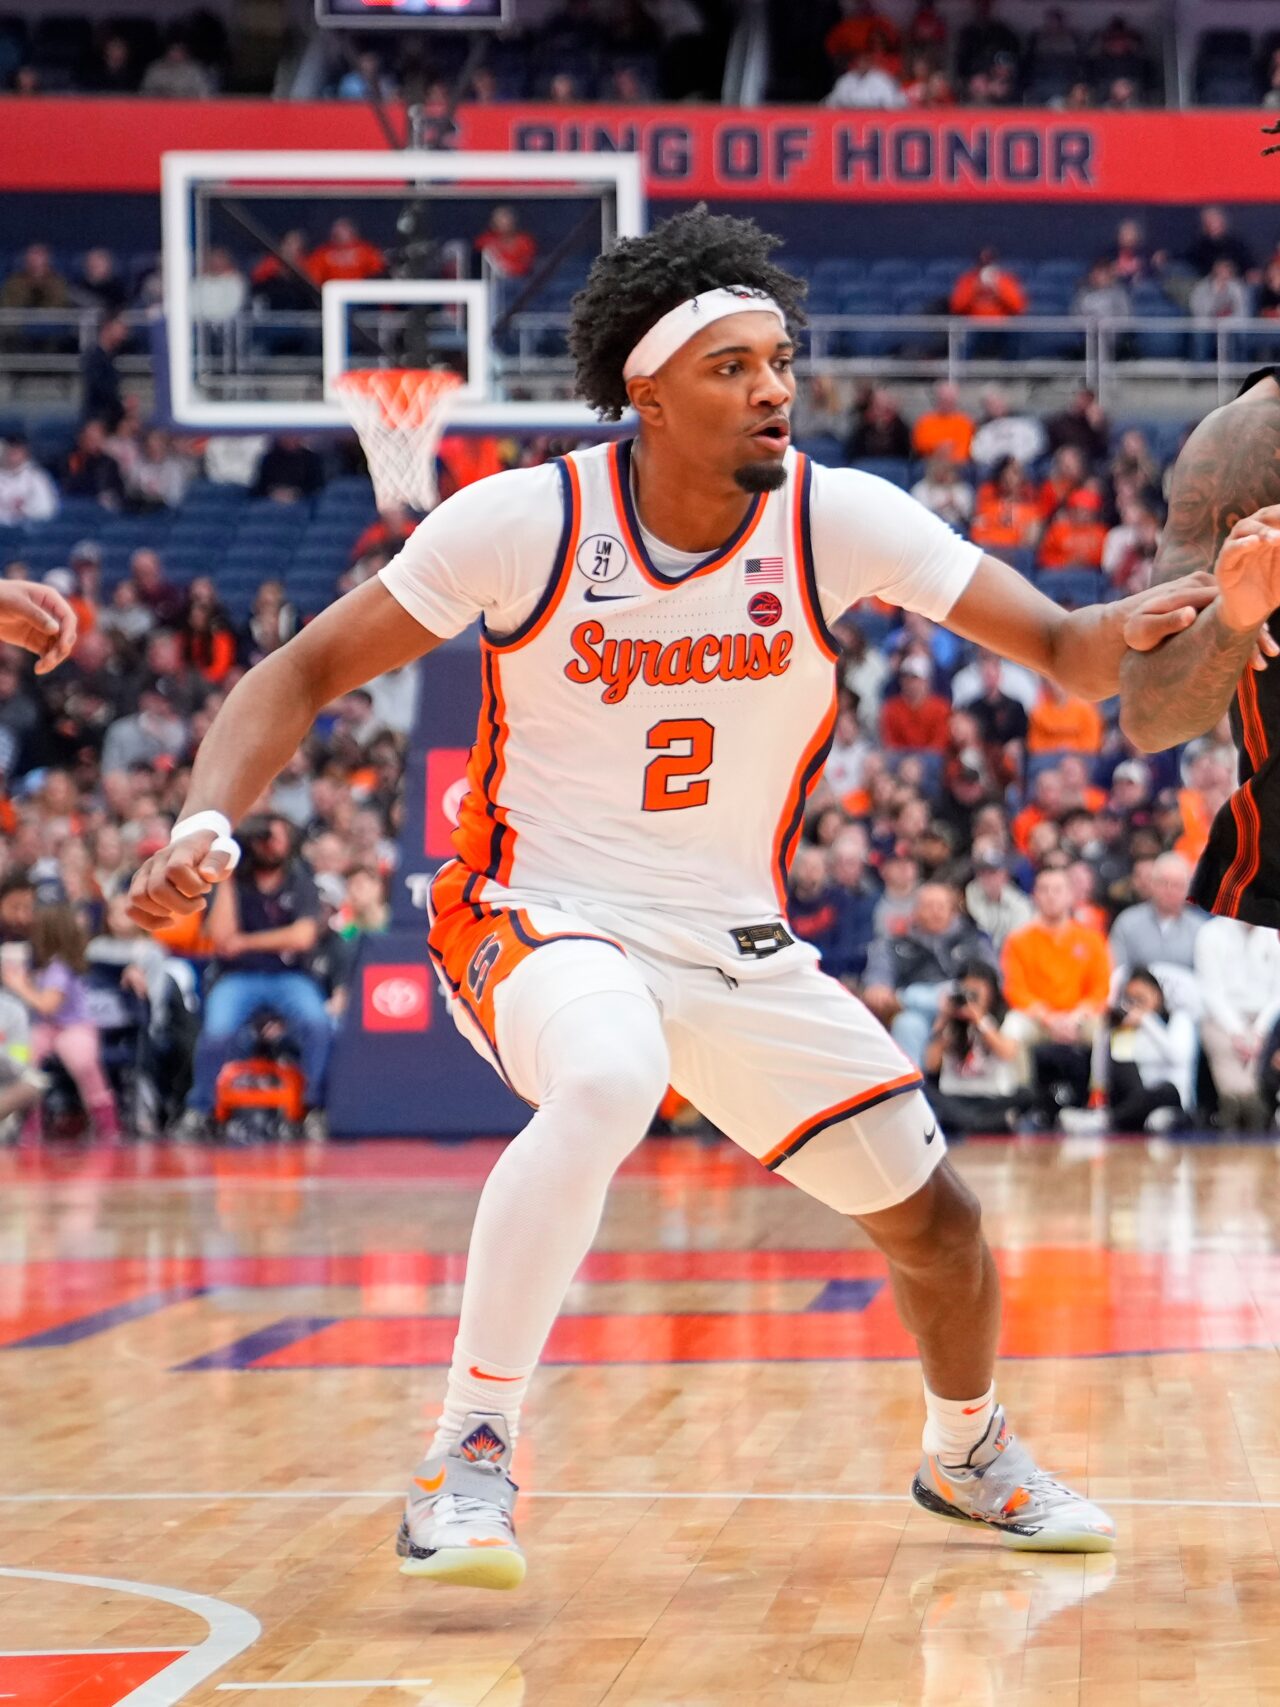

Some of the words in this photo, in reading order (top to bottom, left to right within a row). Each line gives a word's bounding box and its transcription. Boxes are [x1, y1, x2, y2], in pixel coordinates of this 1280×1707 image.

[719, 127, 813, 184] OF
[838, 128, 1094, 184] HONOR
[592, 556, 610, 577] 21
[596, 540, 612, 556] LM
[564, 620, 794, 704] Syracuse
[641, 718, 715, 811] 2
